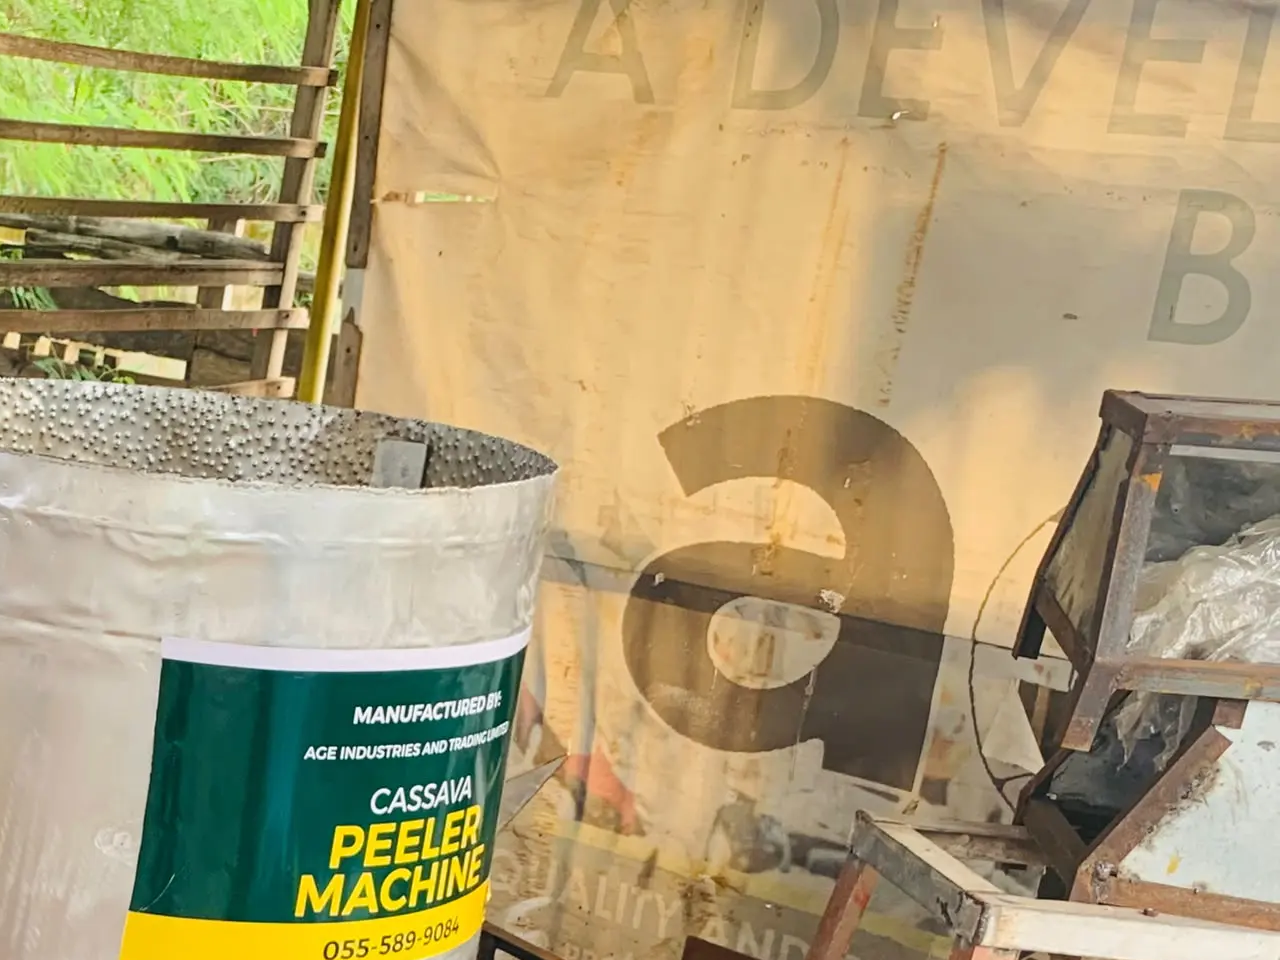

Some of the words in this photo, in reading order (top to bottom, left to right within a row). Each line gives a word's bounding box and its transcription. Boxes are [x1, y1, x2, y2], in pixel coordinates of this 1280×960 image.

[543, 0, 656, 105] A
[1147, 188, 1256, 345] B
[353, 695, 484, 725] MANUFACTURED
[304, 745, 337, 761] AGE
[340, 743, 421, 761] INDUSTRIES
[422, 739, 448, 756] AND
[449, 732, 488, 752] TRADING
[370, 775, 473, 816] CASSAVA
[328, 803, 483, 870] PEELER
[294, 843, 486, 918] MACHINE
